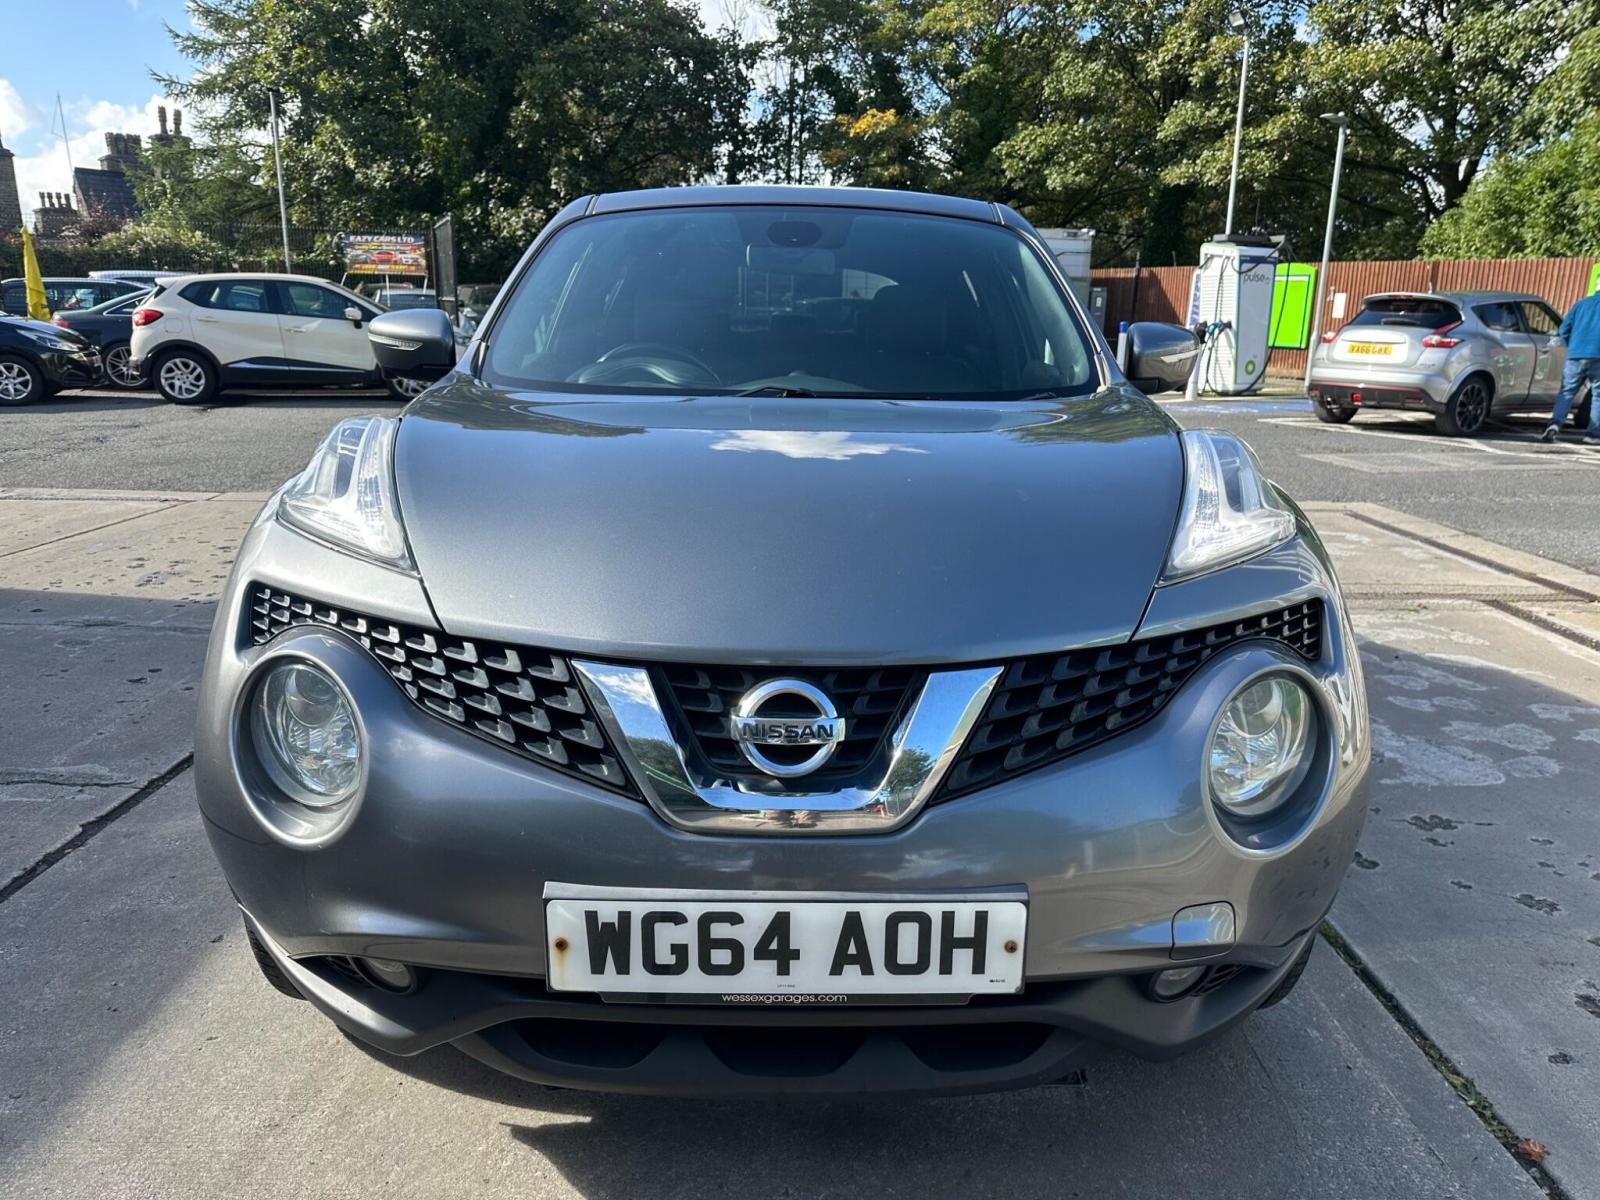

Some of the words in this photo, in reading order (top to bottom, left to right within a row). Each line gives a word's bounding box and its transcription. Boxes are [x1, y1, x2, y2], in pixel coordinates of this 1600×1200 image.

[1243, 271, 1265, 284] pulse
[743, 722, 834, 739] NISSAN
[584, 910, 801, 977] WG64
[828, 910, 989, 976] AOH
[721, 993, 848, 1004] wessexgarages.com
